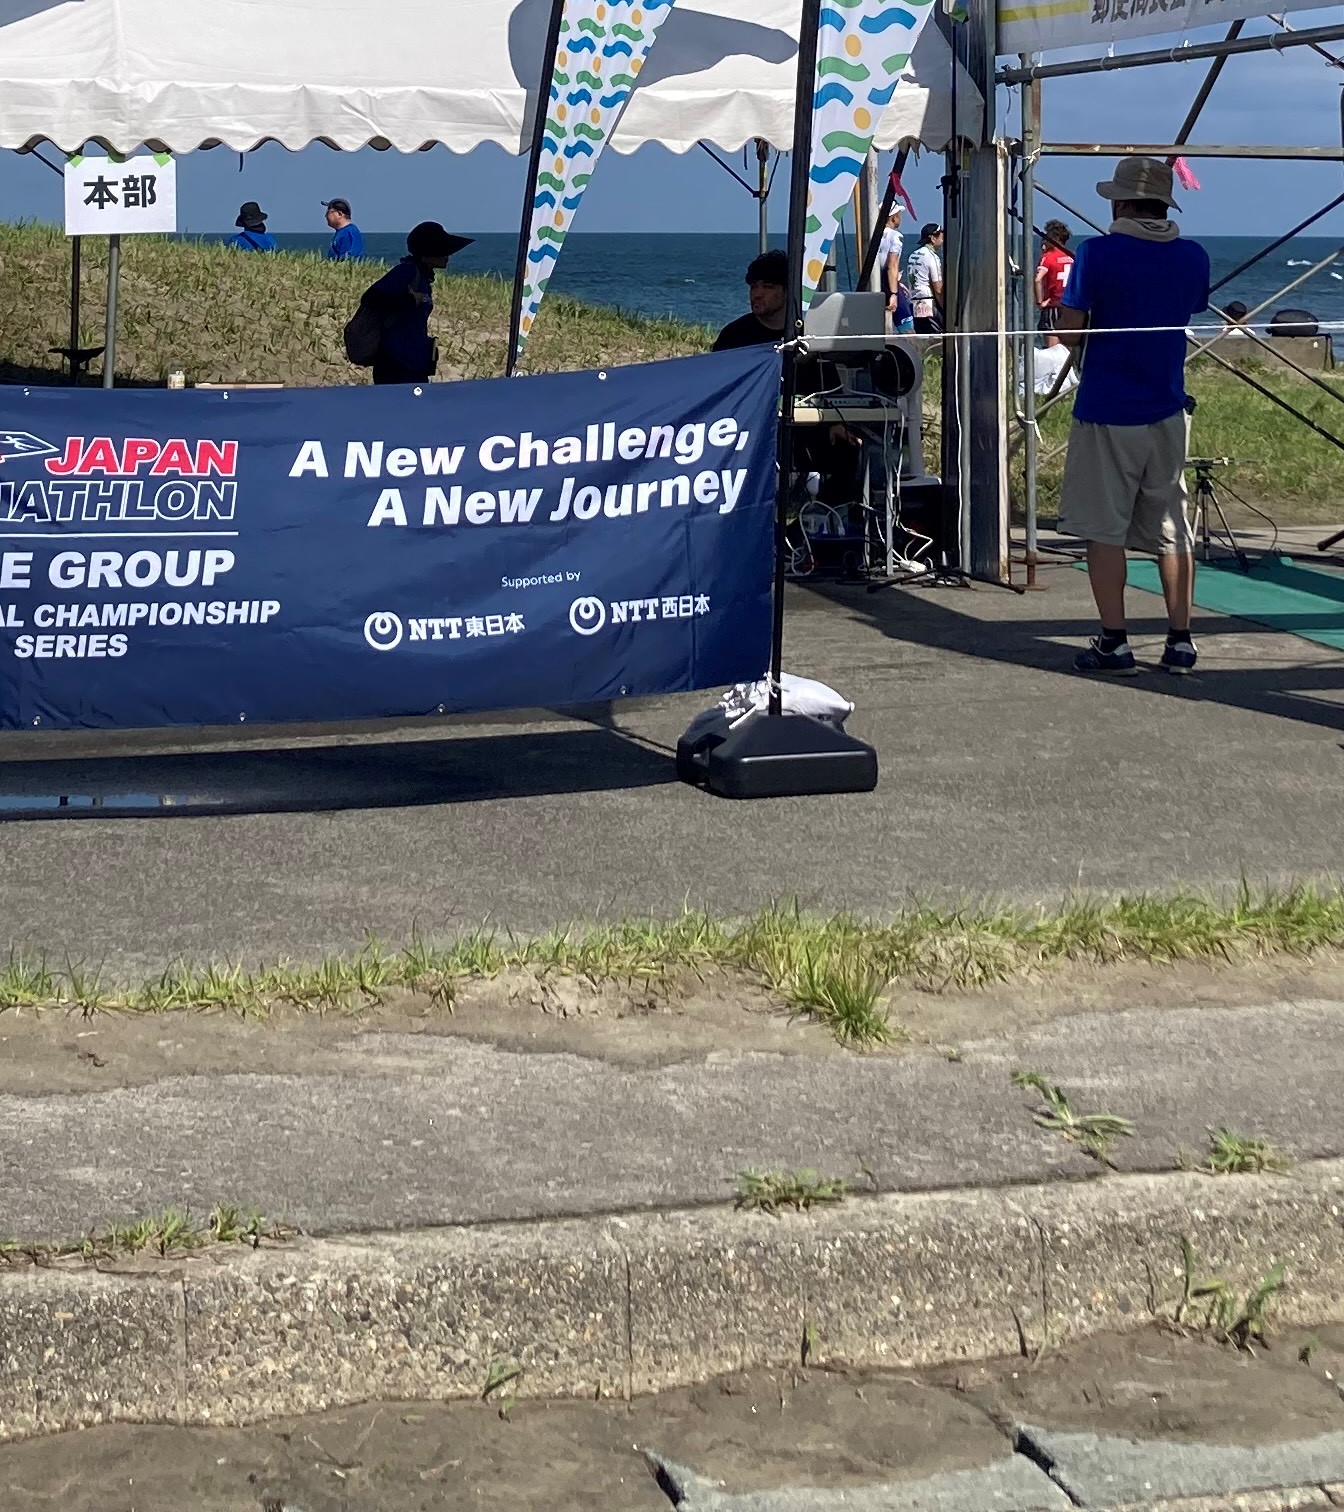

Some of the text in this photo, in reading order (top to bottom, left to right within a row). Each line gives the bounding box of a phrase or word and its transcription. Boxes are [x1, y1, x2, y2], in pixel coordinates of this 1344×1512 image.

[83, 174, 157, 210] 本部
[44, 436, 239, 477] JAPAN
[288, 415, 750, 478] A New Challenge,
[367, 467, 748, 527] A New Journey
[48, 549, 235, 589] GROUP
[501, 570, 581, 589] Supported by
[33, 600, 281, 628] CHAMPIONSHIP
[14, 633, 129, 659] SERIES
